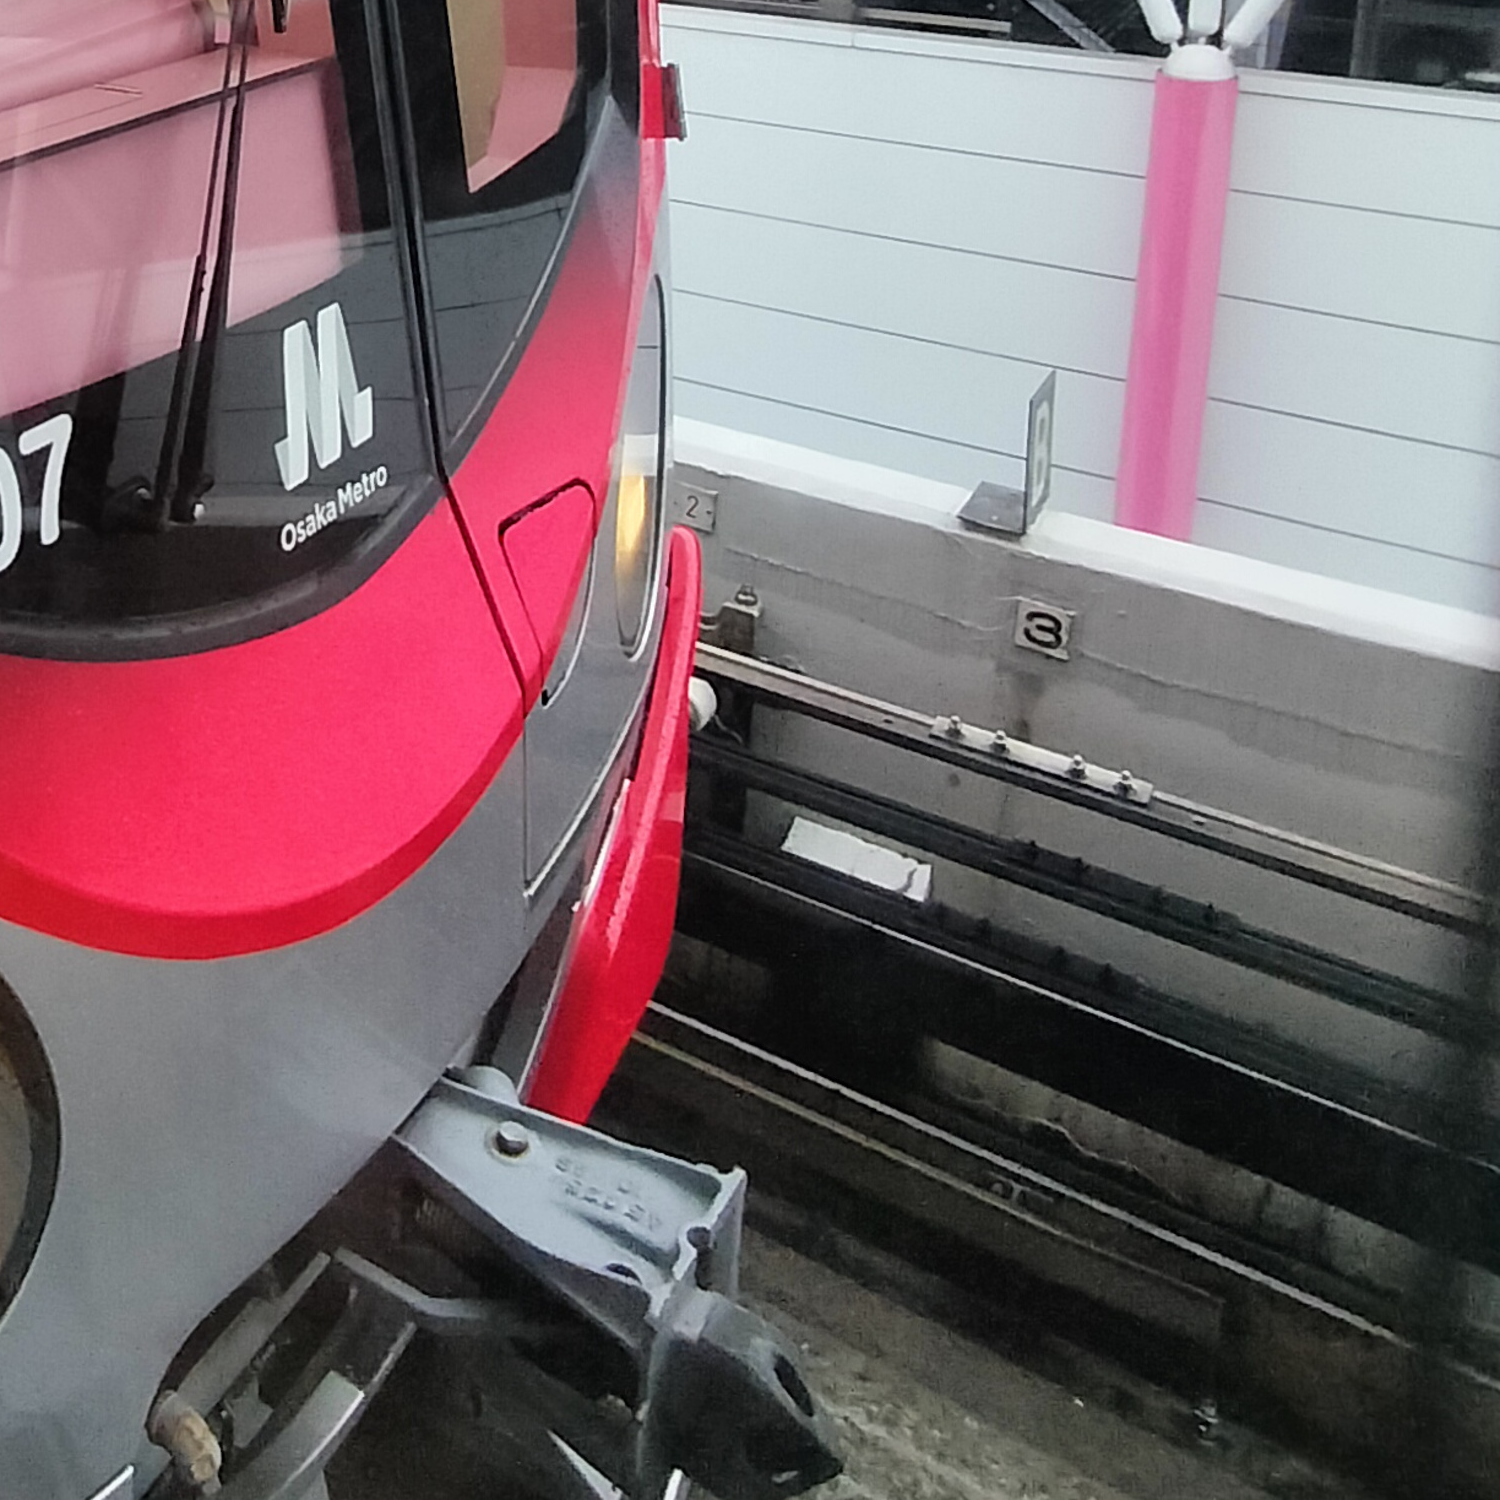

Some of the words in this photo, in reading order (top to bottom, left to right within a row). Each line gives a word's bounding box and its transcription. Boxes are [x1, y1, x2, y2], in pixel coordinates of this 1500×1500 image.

[281, 500, 338, 552] Osaka
[337, 465, 388, 515] Metro
[685, 495, 699, 519] 2
[1023, 610, 1063, 650] 3
